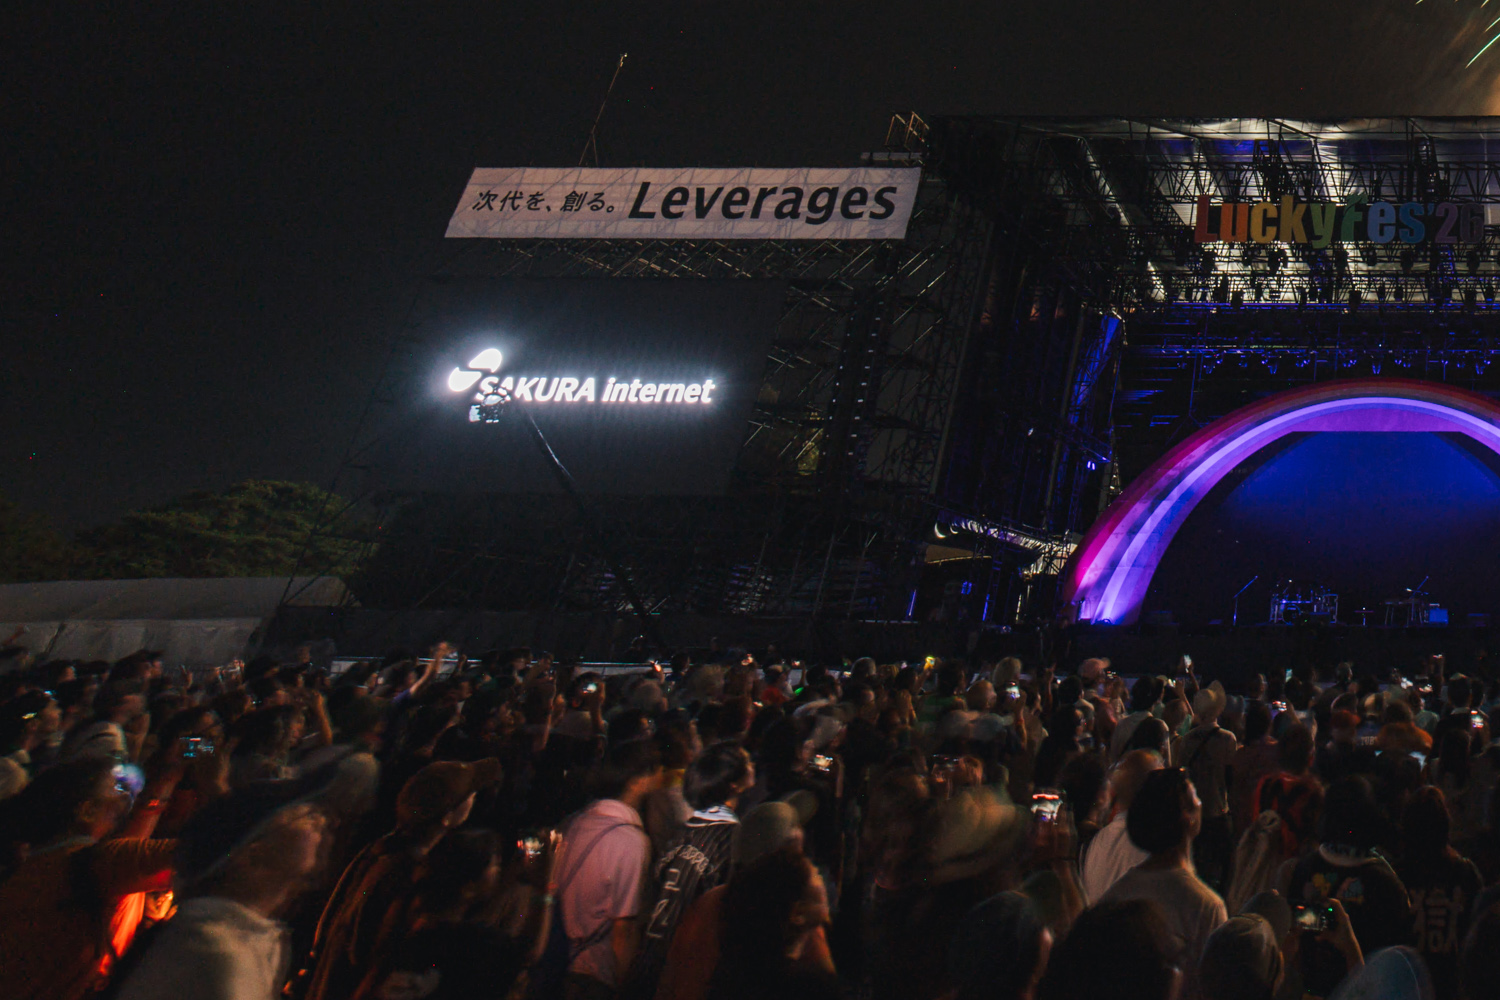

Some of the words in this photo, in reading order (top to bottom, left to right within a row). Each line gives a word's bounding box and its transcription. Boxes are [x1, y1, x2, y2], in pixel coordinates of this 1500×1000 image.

[472, 190, 615, 213] 次代を、創る。
[628, 181, 897, 225] Leverages
[602, 377, 716, 402] internet
